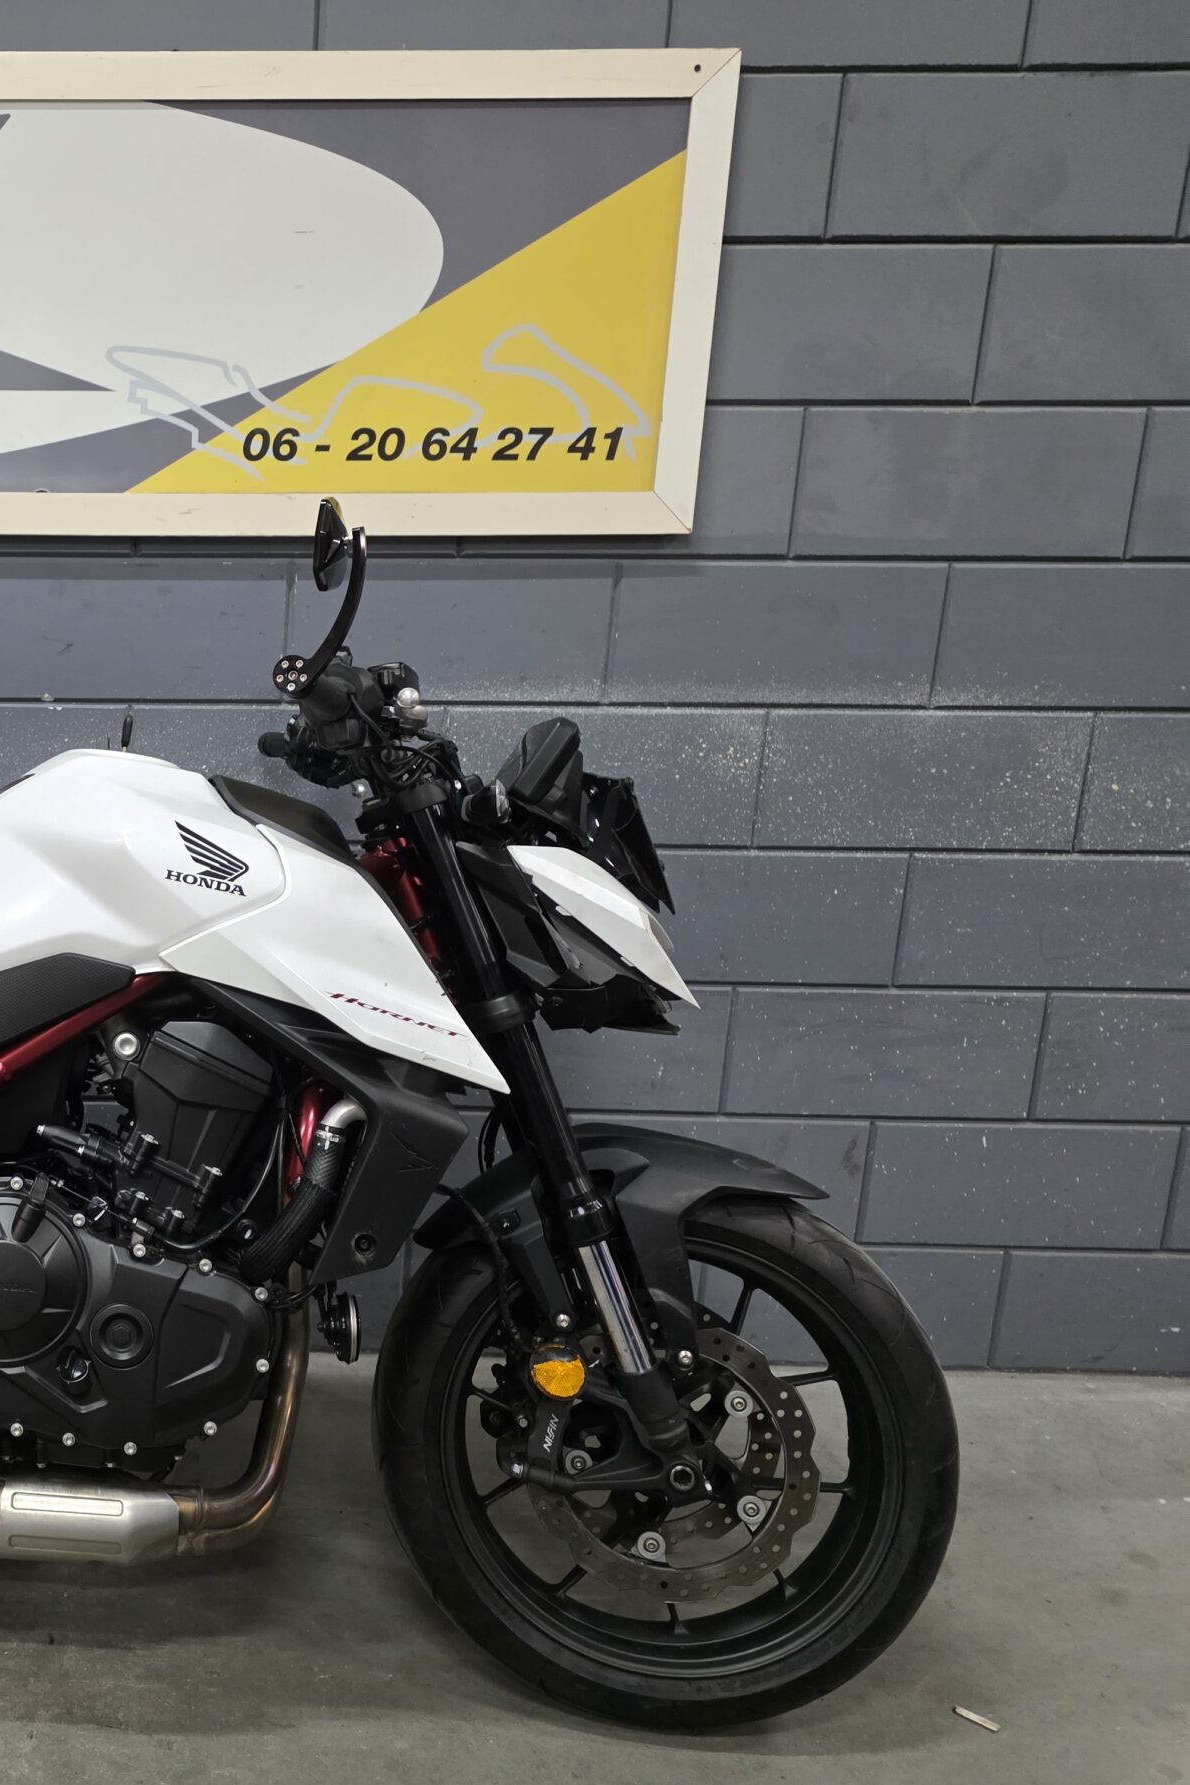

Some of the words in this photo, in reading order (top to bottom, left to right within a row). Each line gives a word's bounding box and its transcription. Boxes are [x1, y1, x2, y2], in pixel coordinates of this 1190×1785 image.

[242, 427, 300, 462] 06
[345, 427, 406, 462] 20
[421, 427, 480, 462] 64
[492, 427, 554, 462] 27
[567, 427, 624, 462] 41
[164, 868, 247, 897] HONDA
